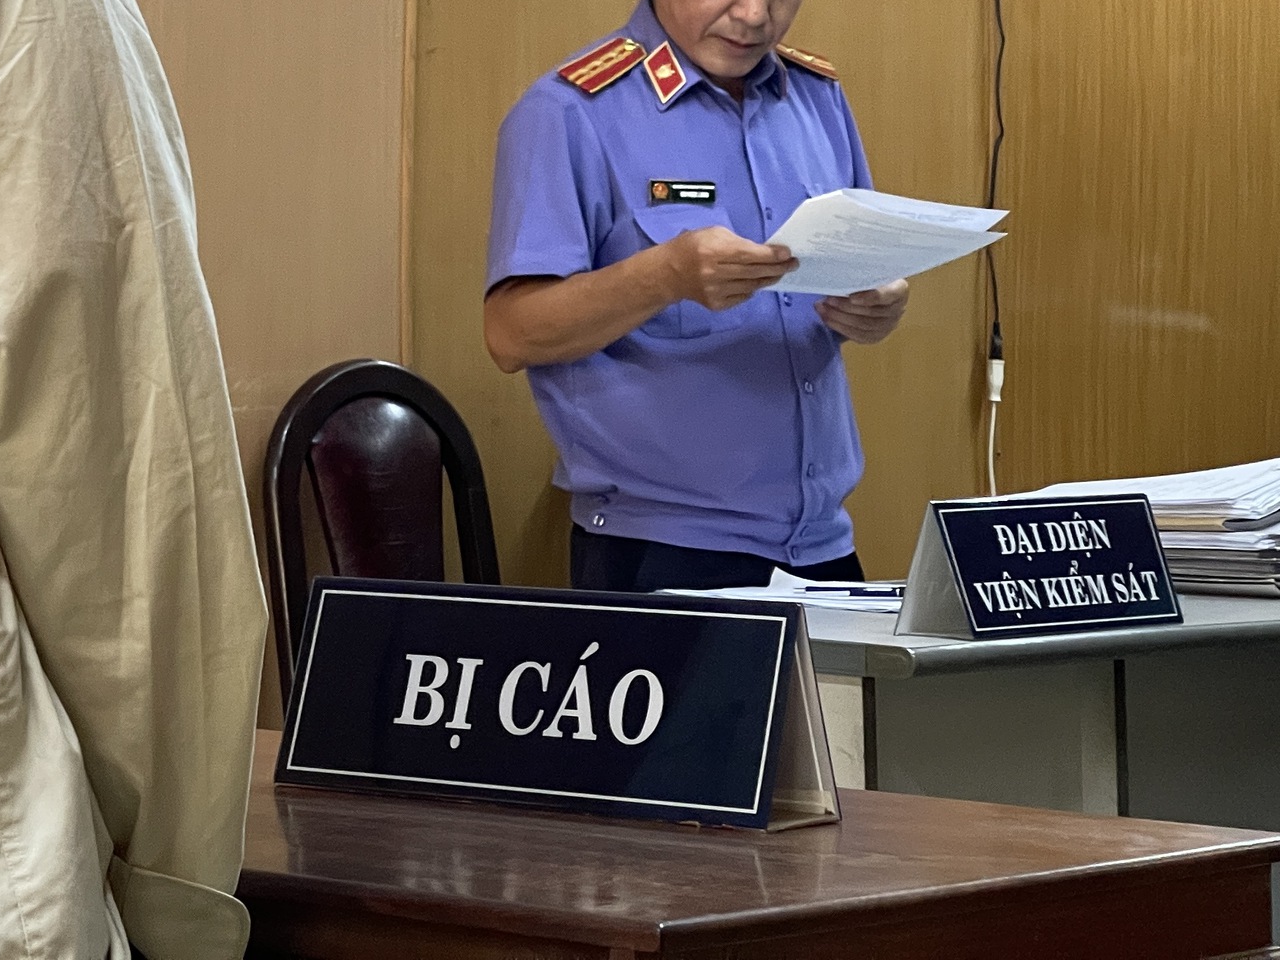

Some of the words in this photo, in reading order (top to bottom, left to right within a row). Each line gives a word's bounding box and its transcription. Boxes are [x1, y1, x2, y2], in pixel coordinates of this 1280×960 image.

[993, 521, 1045, 562] ĐẠI
[1043, 511, 1112, 558] DIỆN
[973, 571, 1042, 619] VIỆN
[1040, 560, 1113, 608] KIỂM
[1110, 562, 1161, 604] SÁT
[392, 653, 484, 750] BỊ
[497, 641, 665, 746] CÁO
